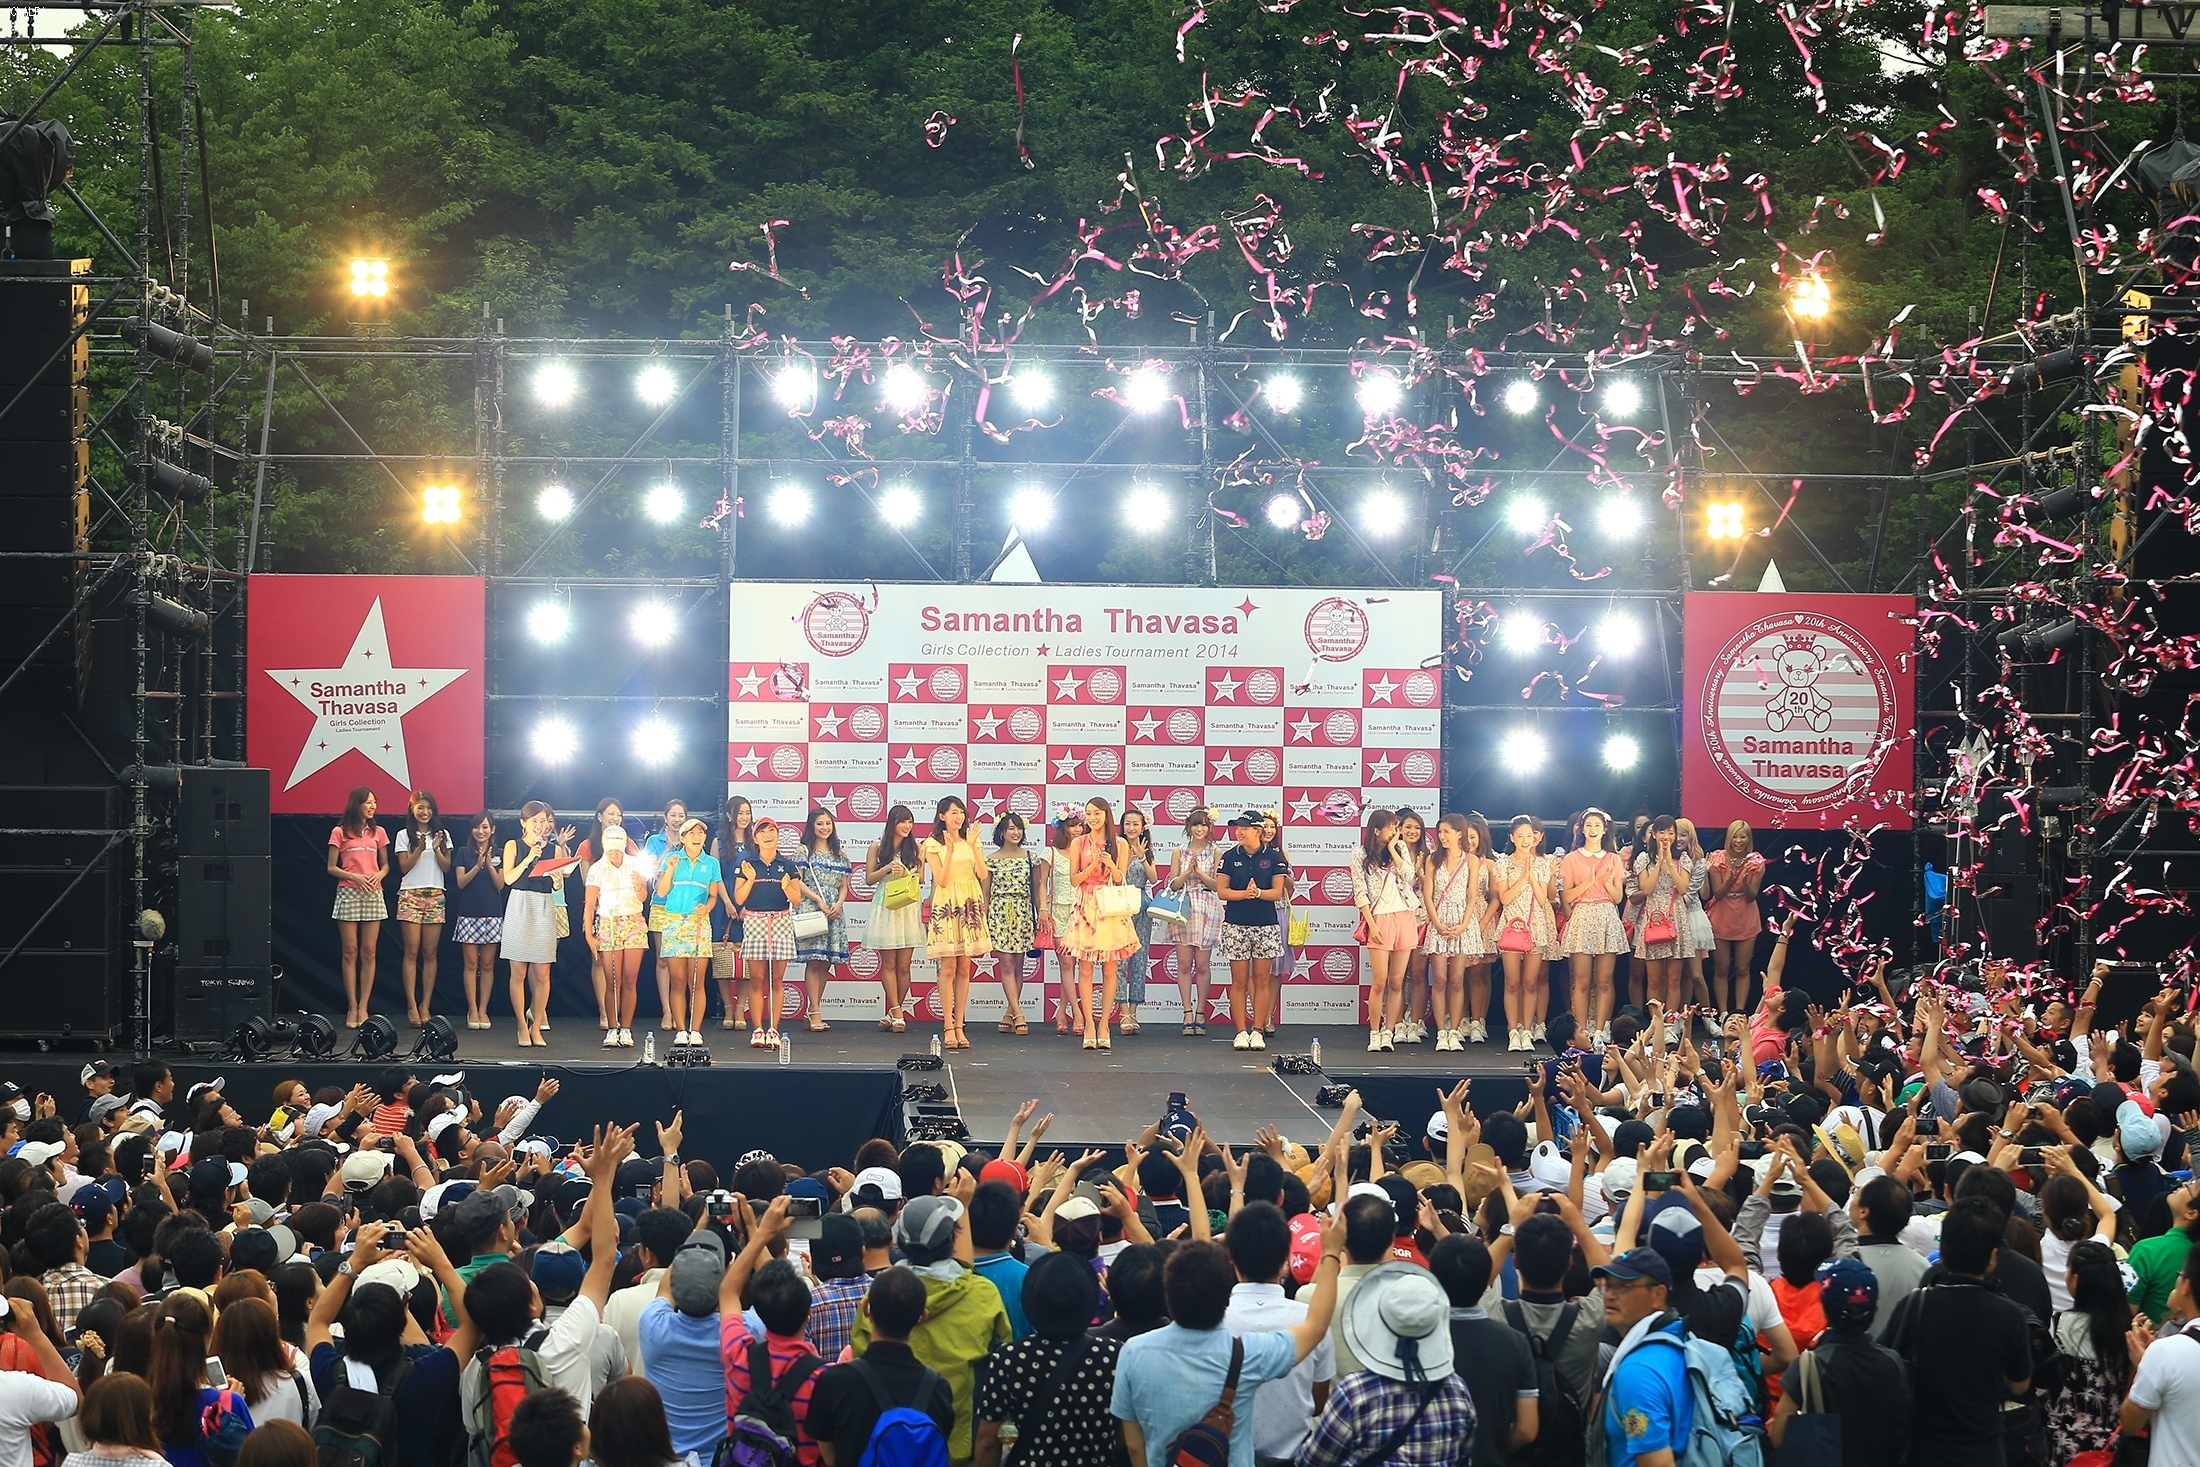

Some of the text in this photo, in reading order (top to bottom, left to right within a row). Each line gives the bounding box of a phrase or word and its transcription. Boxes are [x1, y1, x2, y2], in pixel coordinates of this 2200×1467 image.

[921, 606, 1239, 634] Samantha Thavasa
[817, 631, 855, 639] Samantha
[1317, 636, 1355, 644] Samantha
[820, 639, 852, 647] Thavasa
[921, 643, 1239, 658] Girls Collection Ladies Tournament 2014
[1320, 644, 1352, 652] Thavasa
[1720, 631, 1757, 665] Samantha
[1753, 619, 1795, 633] Thavasa
[1804, 616, 1826, 628] 20th
[1827, 624, 1875, 665] Anniversary
[1873, 668, 1893, 713] Samantha
[310, 680, 406, 698] Samantha
[1703, 667, 1725, 727] Anniversary
[1789, 691, 1808, 706] 20
[318, 700, 398, 716] Thavasa
[1794, 705, 1804, 714] th
[329, 718, 386, 727] Girls Collection
[1706, 729, 1721, 751] 20th
[1743, 735, 1853, 755] Samantha
[1752, 759, 1844, 778] Thavasa
